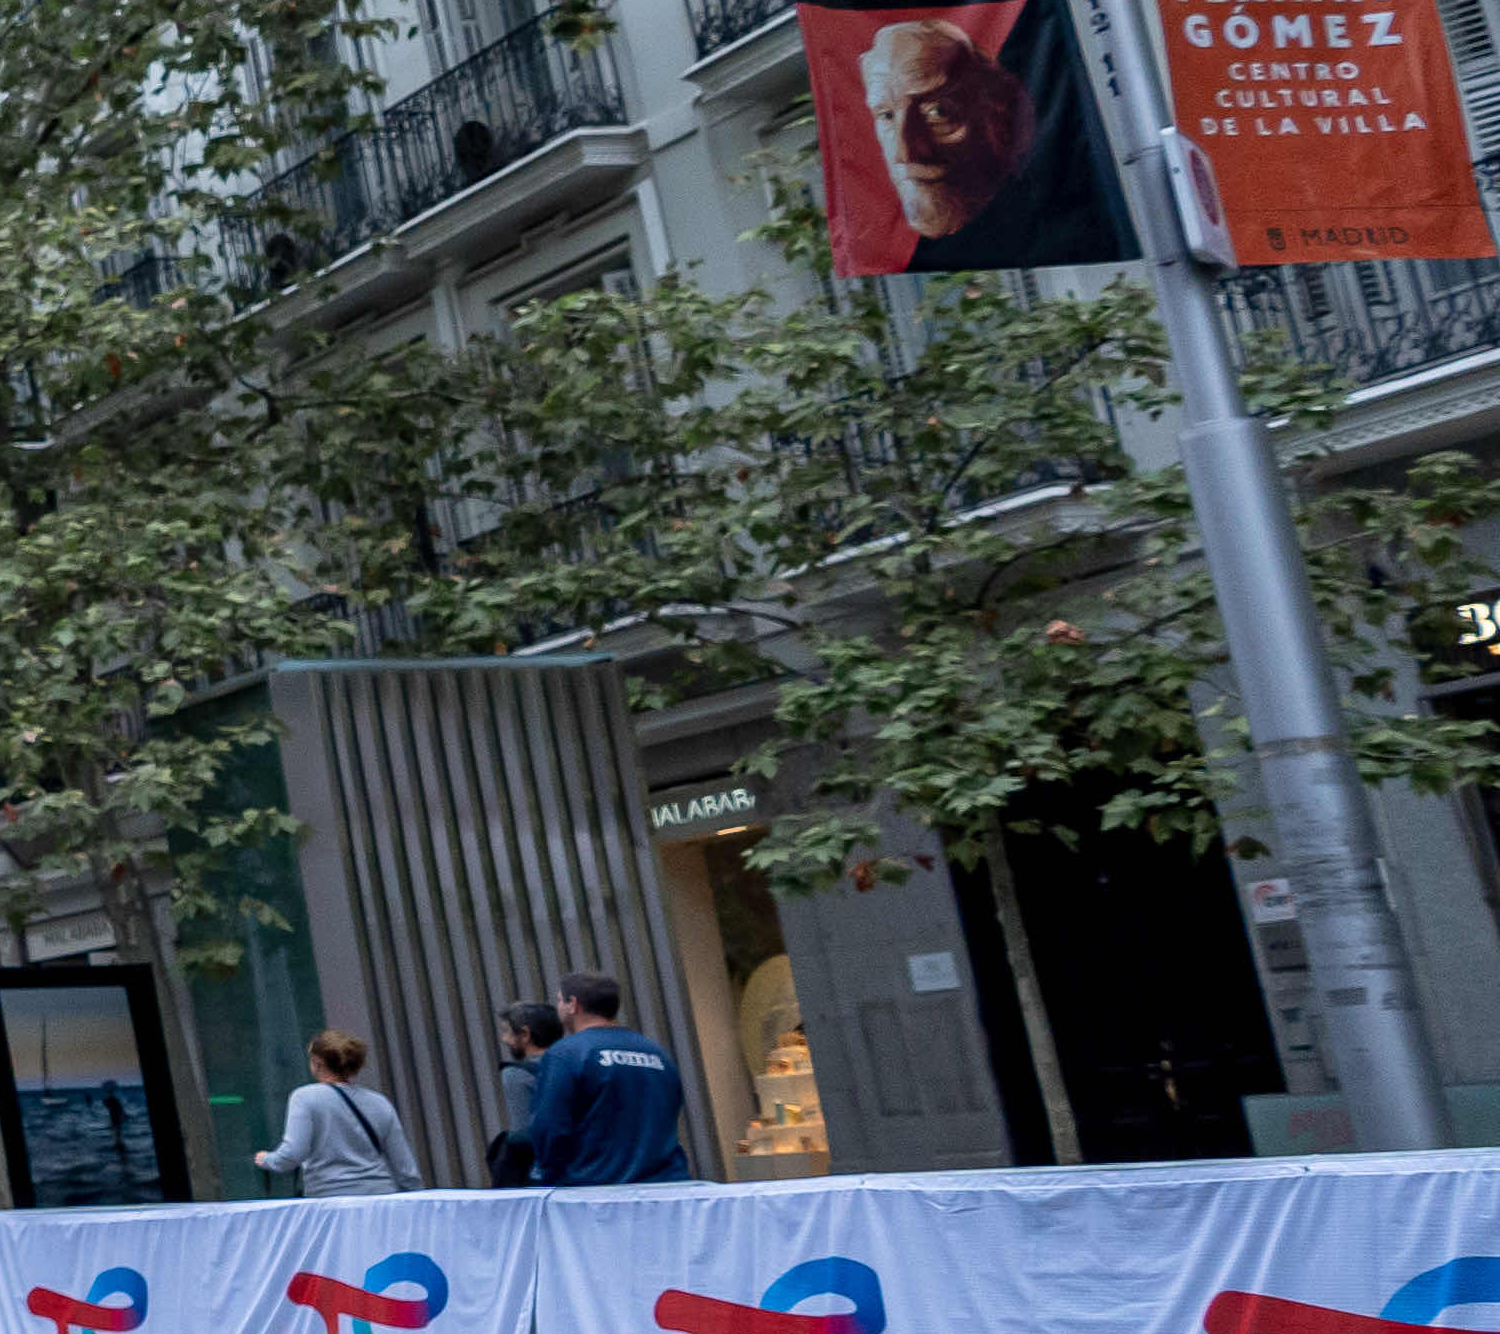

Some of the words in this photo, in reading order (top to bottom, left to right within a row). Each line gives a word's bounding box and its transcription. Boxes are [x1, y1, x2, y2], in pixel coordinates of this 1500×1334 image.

[1184, 5, 1403, 49] GÓMEZ
[1227, 61, 1360, 81] CENTRO
[1215, 87, 1391, 108] CULTURAL
[1200, 117, 1240, 136] DE
[1256, 117, 1300, 136] LA
[1314, 112, 1428, 135] VILLA
